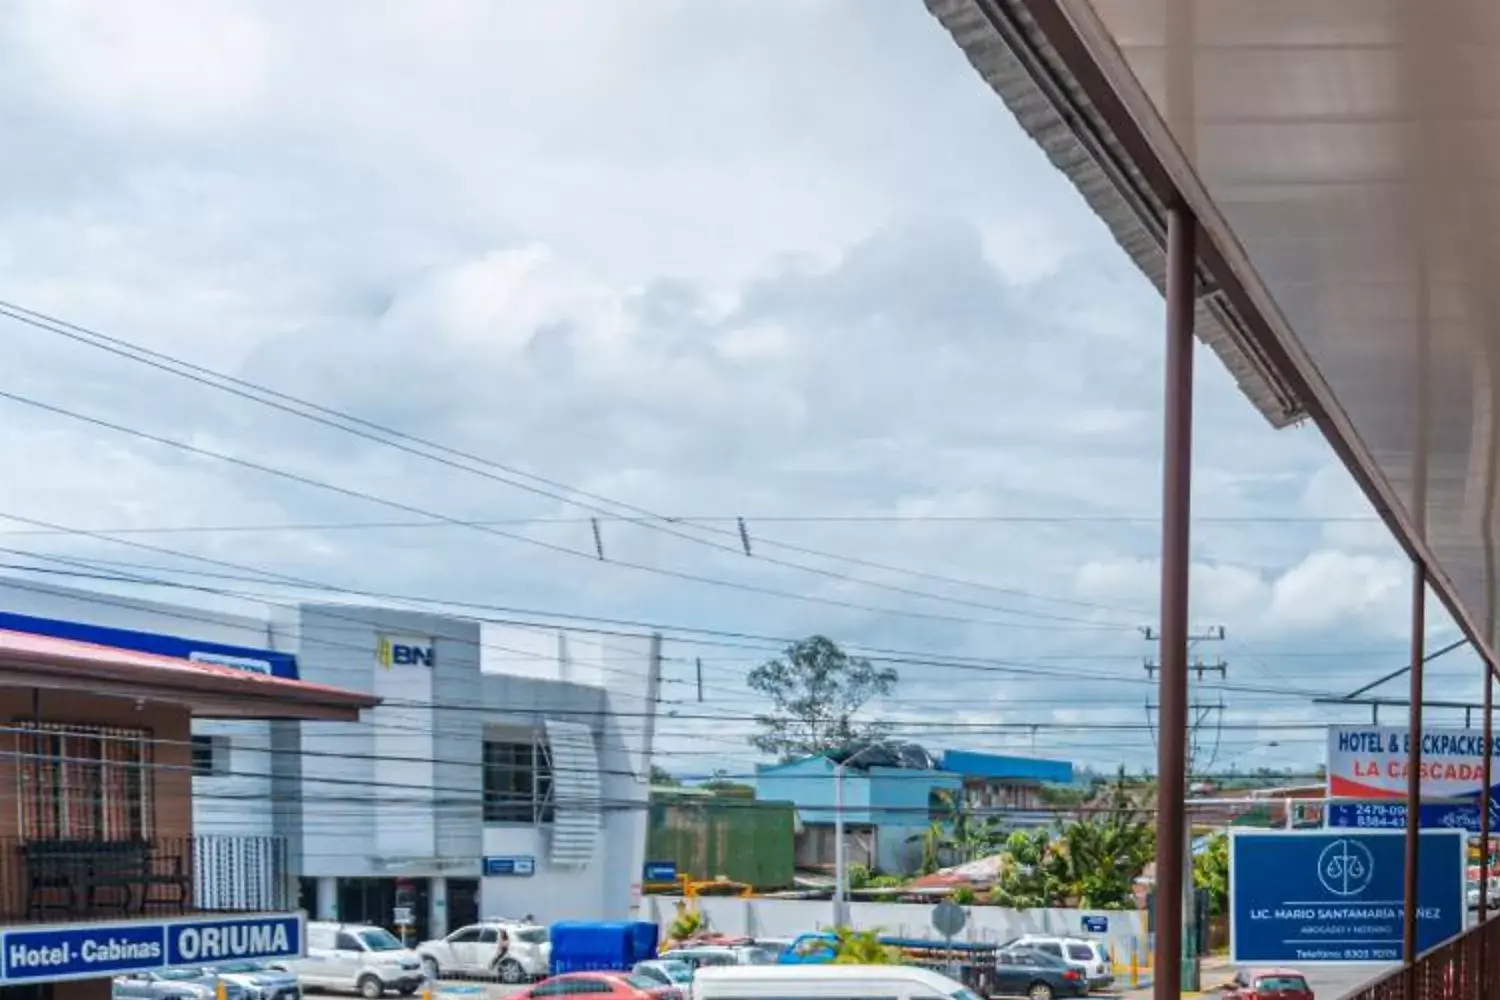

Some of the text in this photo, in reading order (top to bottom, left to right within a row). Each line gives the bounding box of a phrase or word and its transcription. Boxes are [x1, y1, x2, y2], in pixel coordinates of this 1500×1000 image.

[1339, 732, 1384, 752] HOTEL
[1389, 734, 1398, 751] &
[1354, 761, 1379, 777] LA
[1251, 908, 1272, 919] LIC.
[1275, 908, 1315, 919] MARIO
[1398, 907, 1442, 920] NÑEZ
[178, 923, 289, 960] ORIUMA
[10, 942, 69, 969] Hotel
[81, 939, 161, 963] Cabinas
